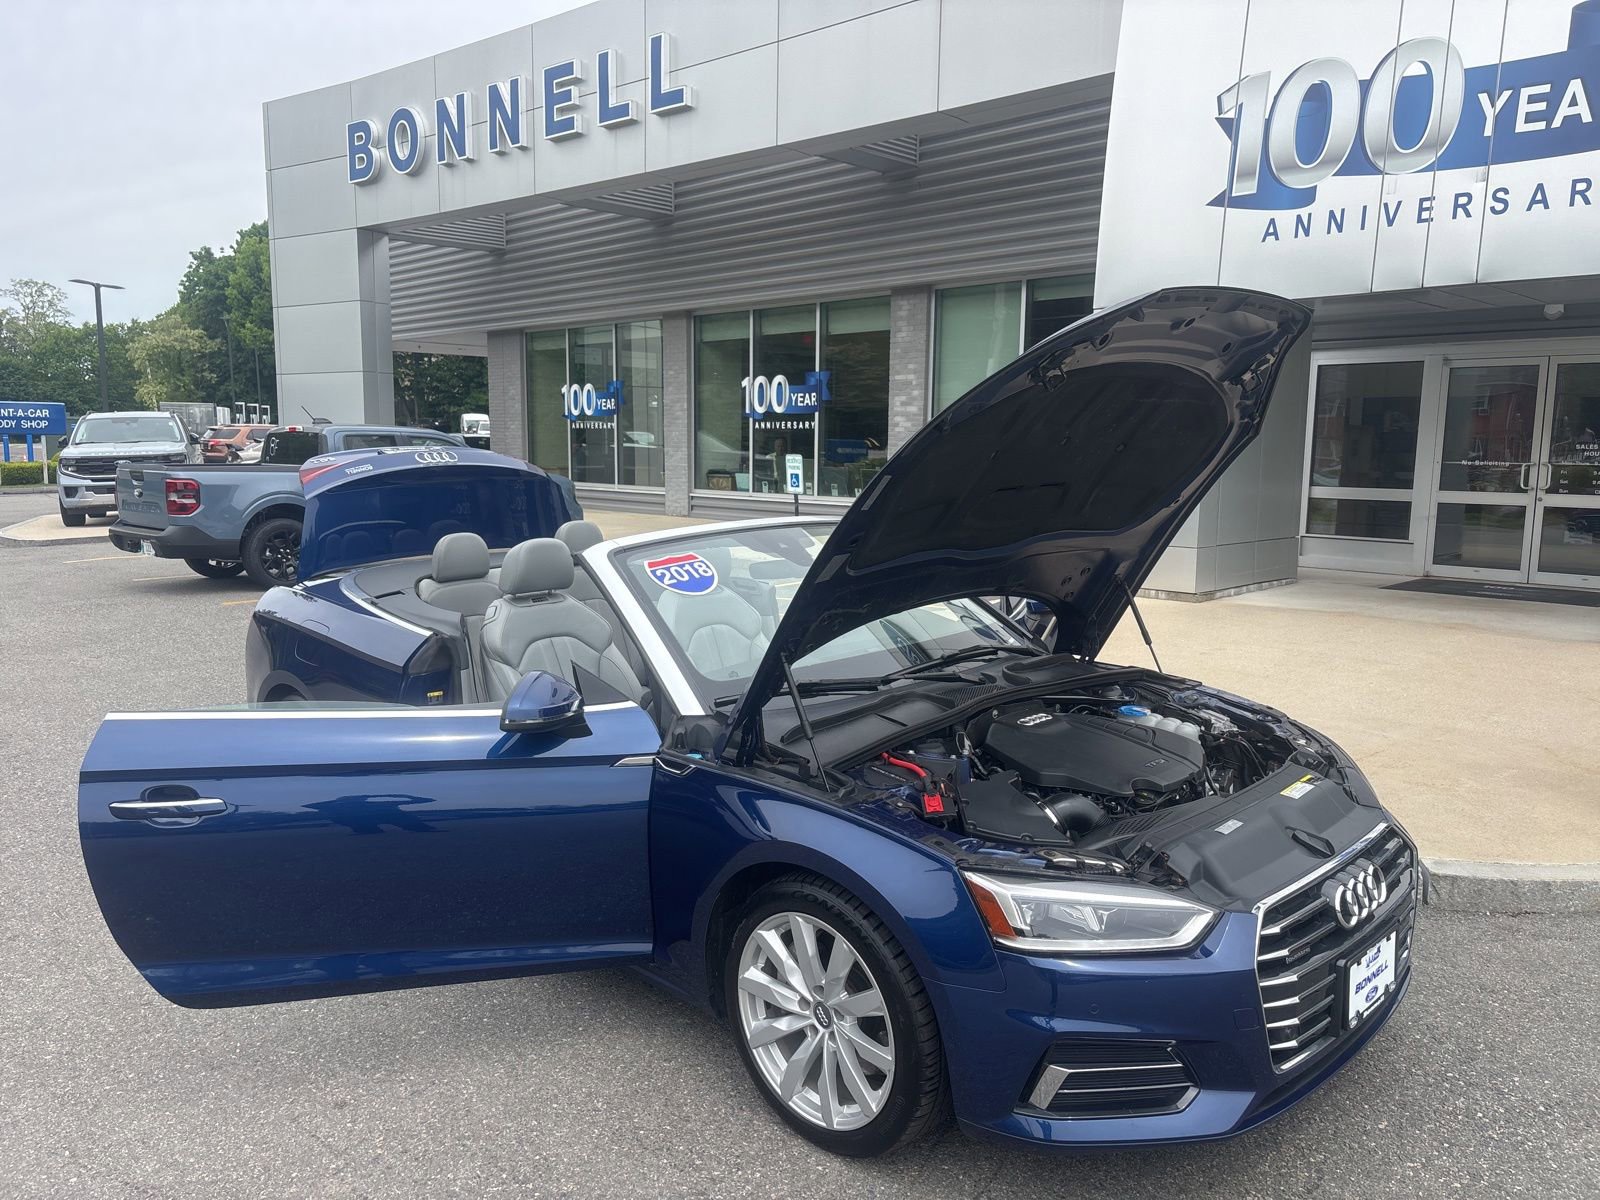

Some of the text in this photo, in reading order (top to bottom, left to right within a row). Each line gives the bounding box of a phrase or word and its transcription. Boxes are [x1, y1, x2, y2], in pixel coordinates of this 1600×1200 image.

[346, 32, 693, 184] BONNELL
[1217, 37, 1593, 197] 100 YEA
[1261, 177, 1593, 243] ANNIVERSAR
[561, 383, 596, 416] 100
[741, 374, 818, 414] 100 YEAR
[20, 419, 49, 429] SHOP
[755, 421, 816, 430] ANNIVERSARY
[655, 561, 713, 585] 2018
[1354, 960, 1389, 996] BONNELL
